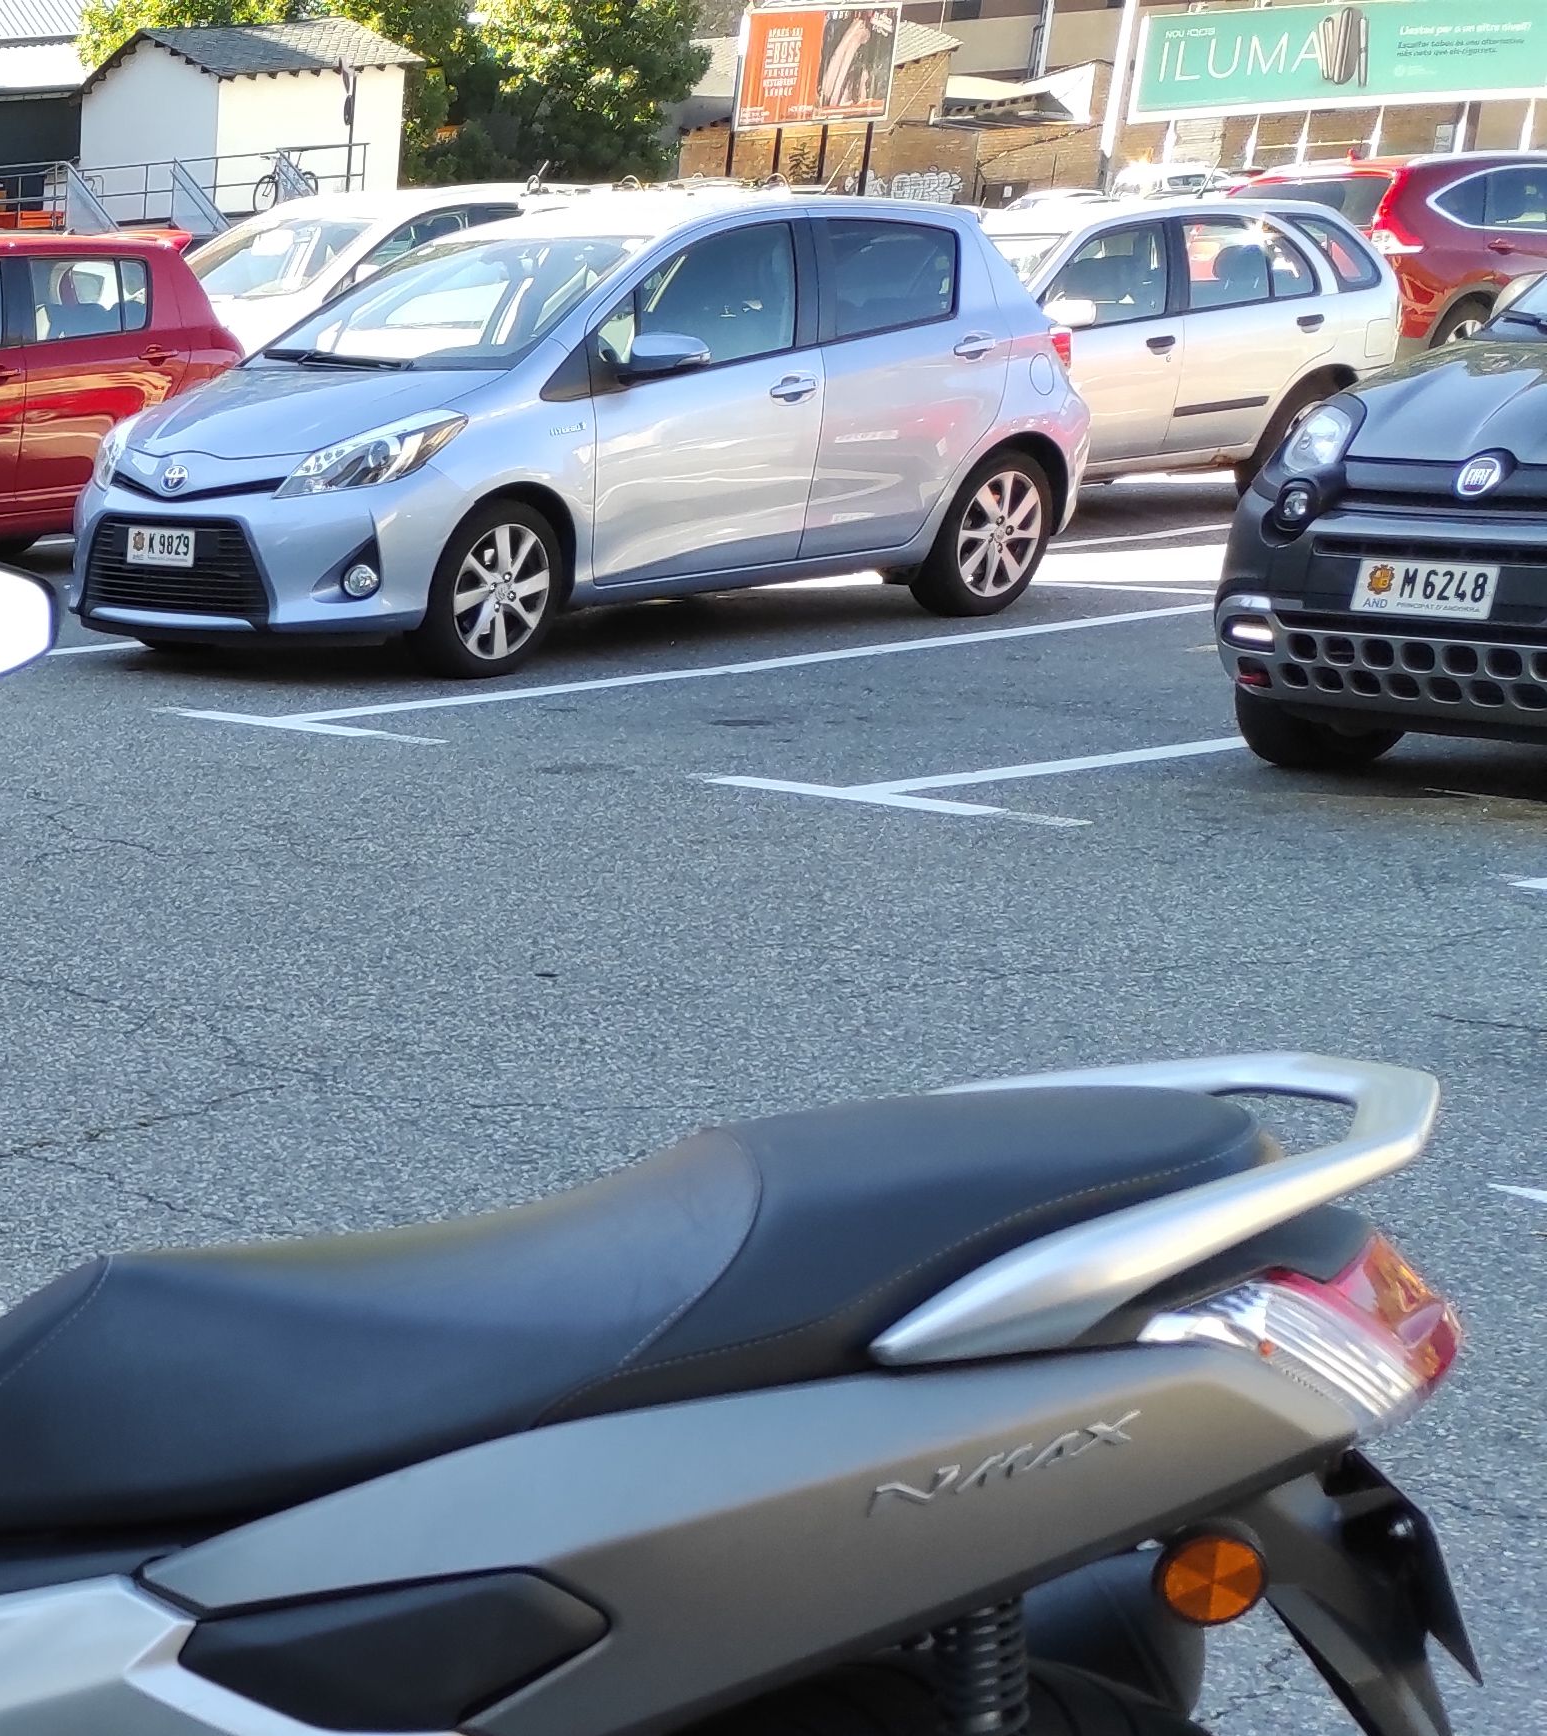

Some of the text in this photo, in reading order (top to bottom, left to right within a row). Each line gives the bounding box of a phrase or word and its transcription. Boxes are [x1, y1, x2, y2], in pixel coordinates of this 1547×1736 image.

[773, 41, 802, 64] BOSS
[1159, 31, 1324, 82] ILUMA
[1464, 468, 1493, 486] FIAT
[159, 533, 190, 556] 9829
[1399, 567, 1489, 604] M 6248
[1363, 597, 1388, 609] AND
[1396, 601, 1435, 610] PRINCIPAT
